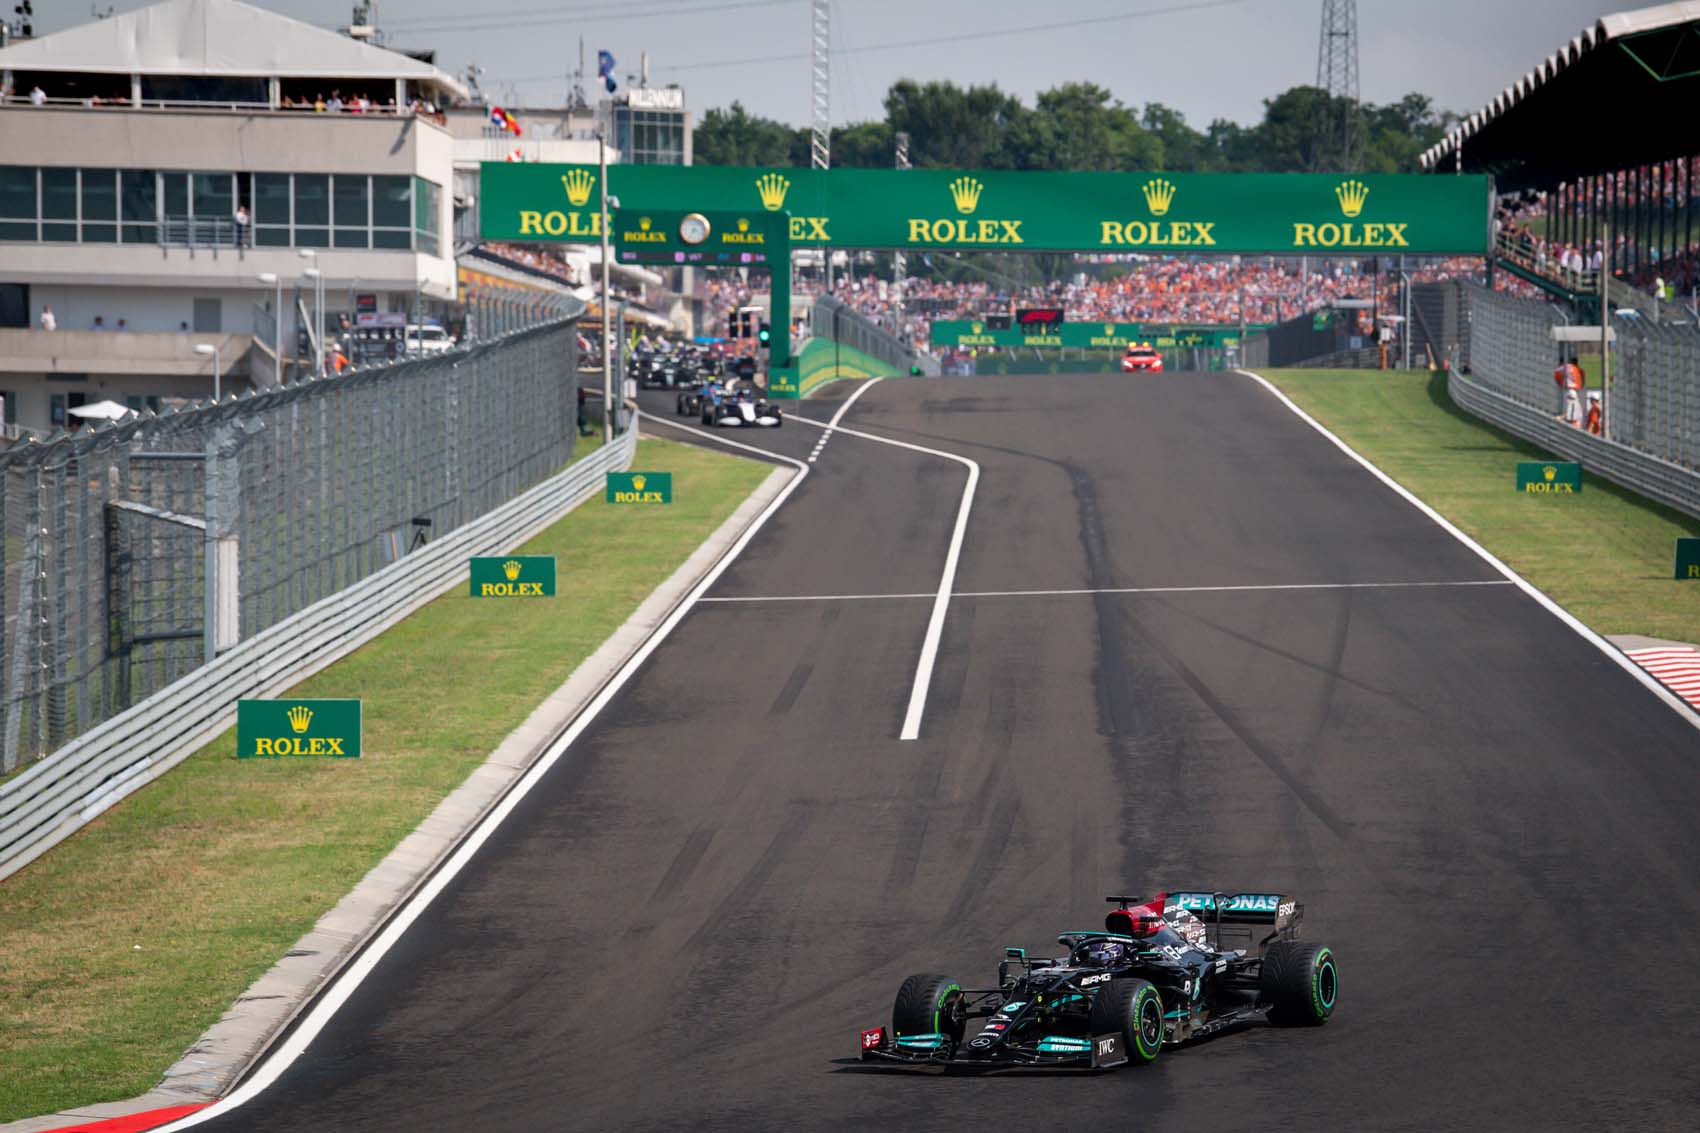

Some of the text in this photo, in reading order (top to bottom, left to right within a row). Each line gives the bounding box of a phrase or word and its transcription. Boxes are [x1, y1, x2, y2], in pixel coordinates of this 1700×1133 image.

[519, 210, 613, 236] ROLE
[907, 218, 1024, 244] ROLEX
[623, 231, 667, 243] ROLEX
[722, 232, 765, 244] ROLEX
[1100, 220, 1216, 246] ROLEX
[1293, 222, 1409, 248] ROLEX
[1525, 482, 1574, 494] ROLEX
[614, 491, 664, 503] ROLEX
[480, 582, 544, 597] ROLEX
[254, 737, 345, 757] ROLEX
[1085, 973, 1112, 985] AMG
[1098, 1038, 1115, 1056] IWC
